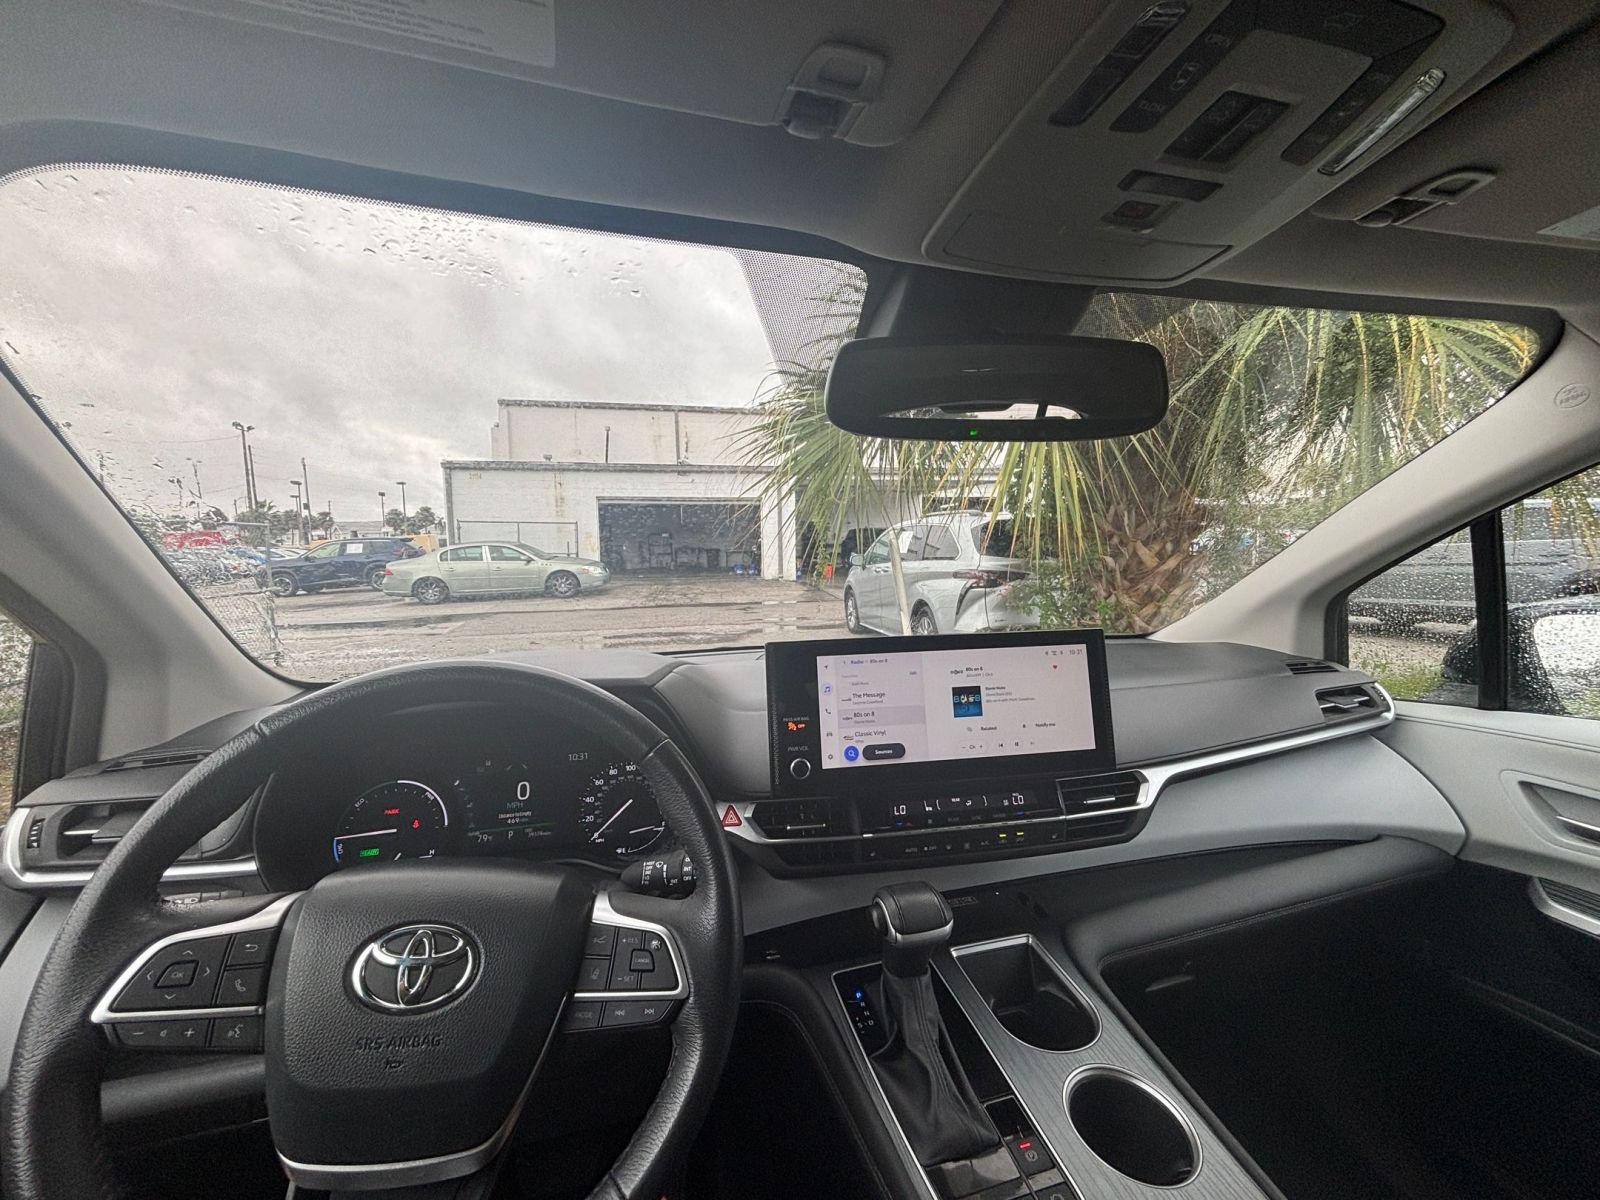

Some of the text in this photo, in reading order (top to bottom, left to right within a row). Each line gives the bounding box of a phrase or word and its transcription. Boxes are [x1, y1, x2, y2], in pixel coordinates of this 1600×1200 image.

[568, 752, 588, 761] 10:31
[517, 781, 530, 800] 0
[354, 798, 365, 808] ECO
[506, 801, 524, 810] MPH
[893, 805, 906, 815] LO
[508, 831, 515, 841] P
[355, 1034, 443, 1052] SRS AIRBAG
